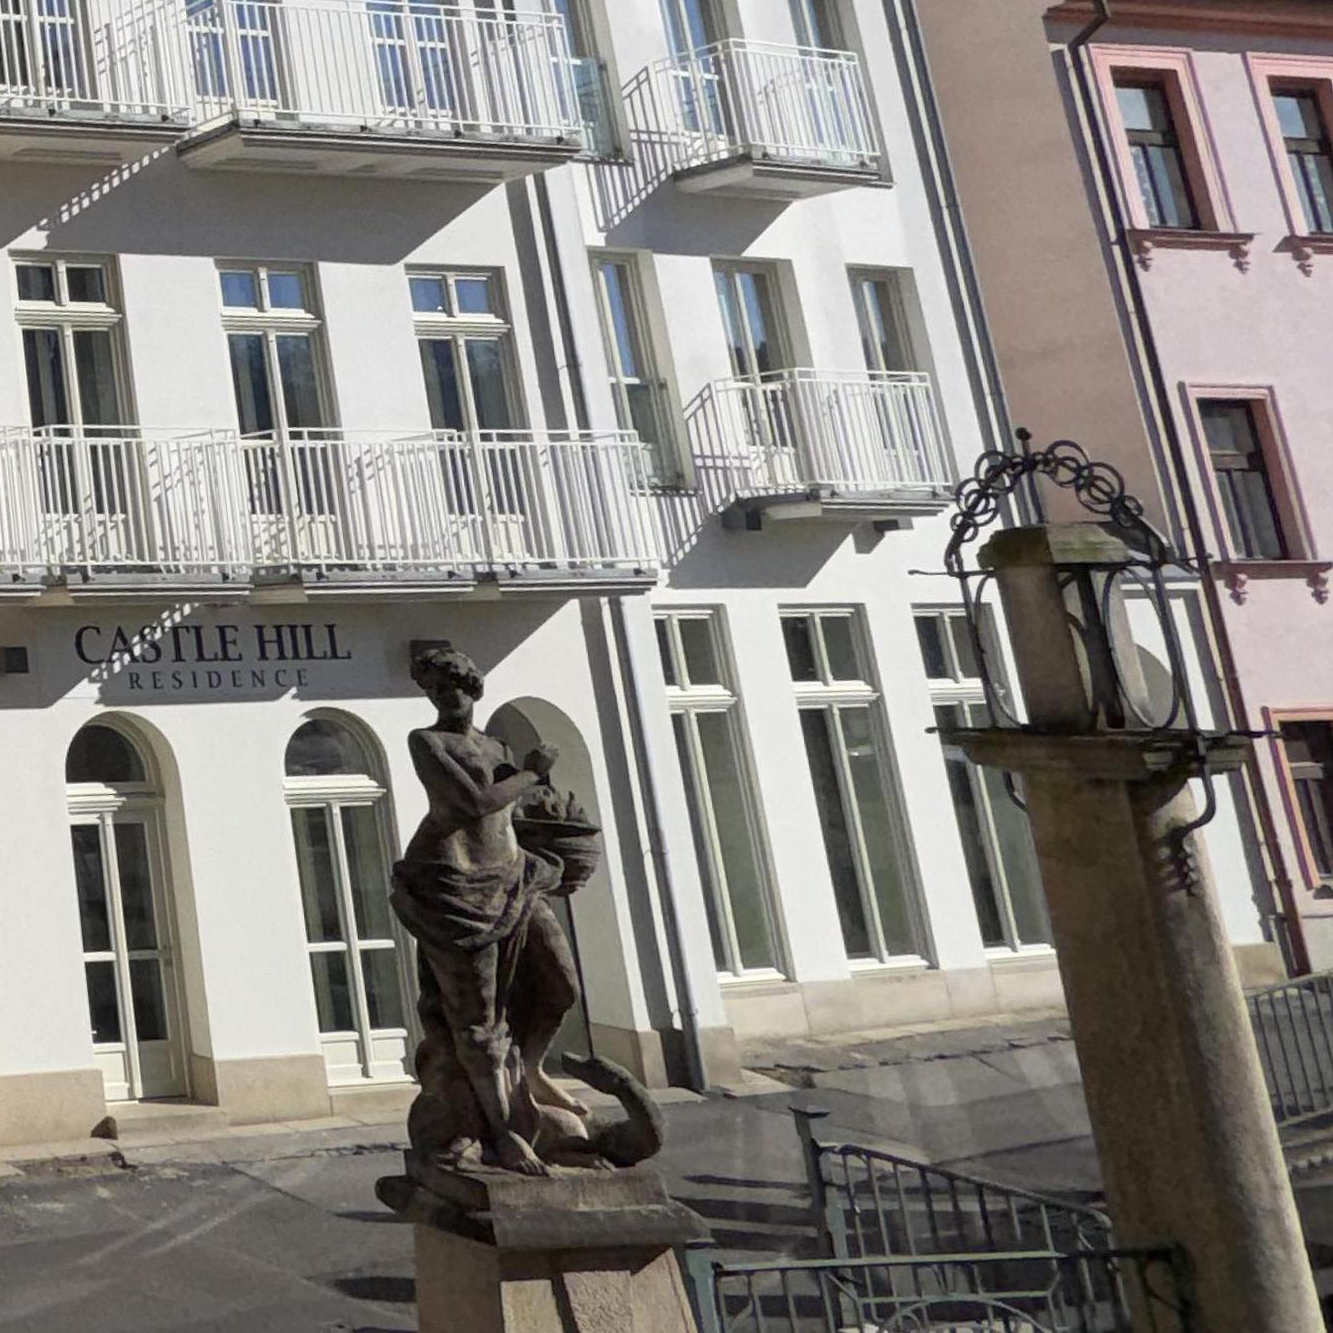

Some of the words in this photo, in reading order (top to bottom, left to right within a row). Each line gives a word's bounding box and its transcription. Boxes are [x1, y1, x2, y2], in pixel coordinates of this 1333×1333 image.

[75, 624, 242, 665] CASTLE
[253, 623, 352, 661] HILL
[129, 668, 309, 690] RESIDENCE
